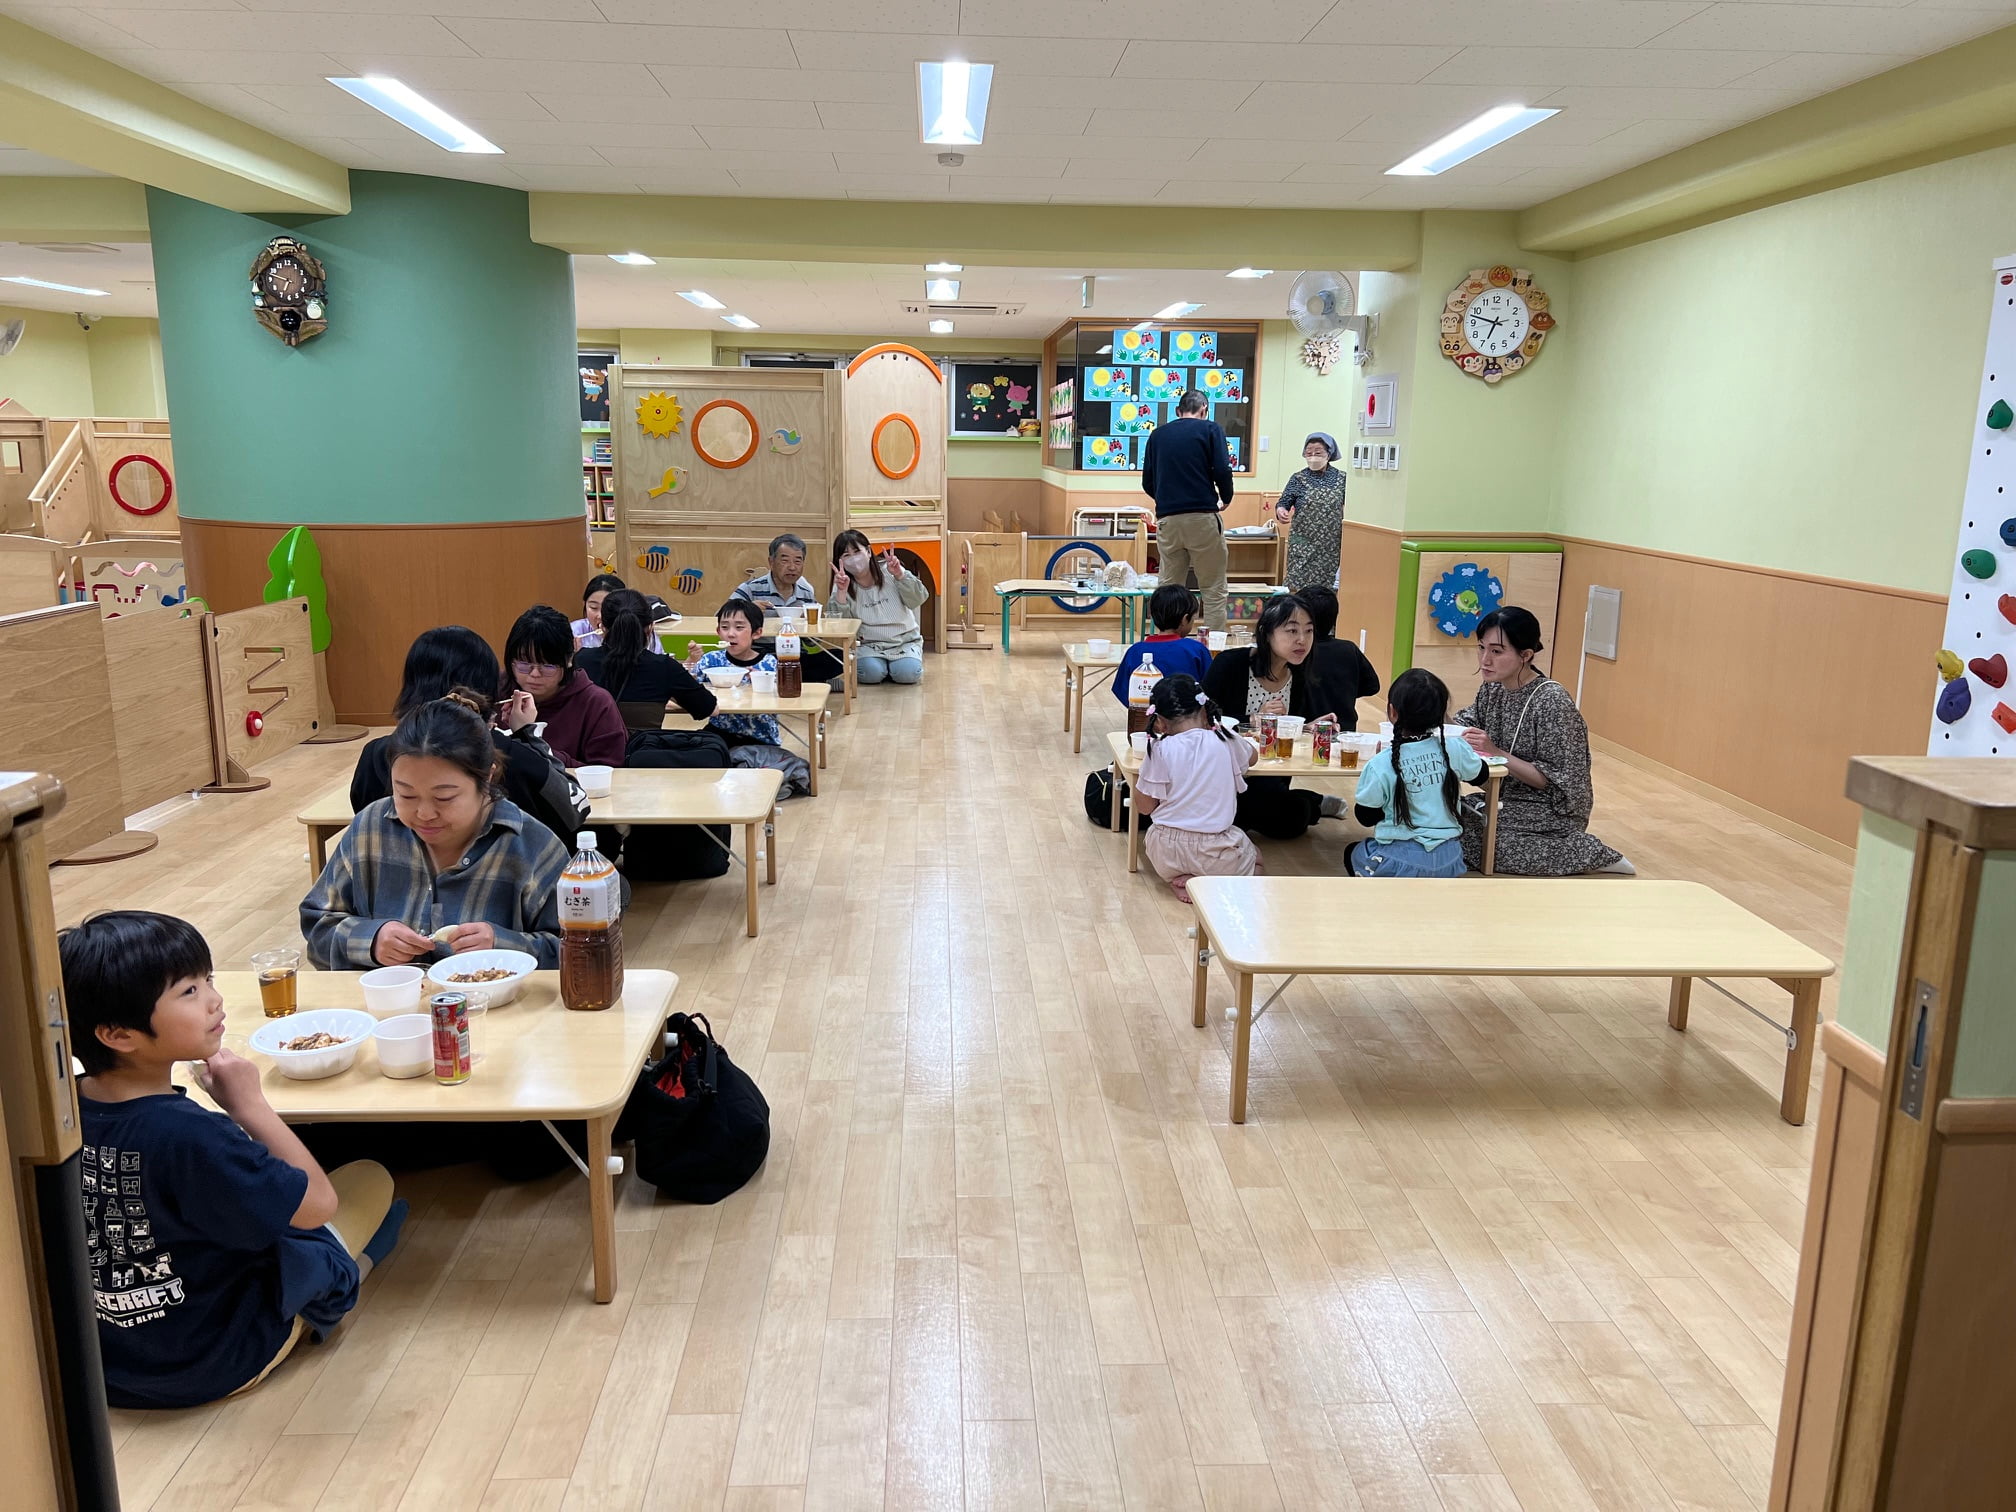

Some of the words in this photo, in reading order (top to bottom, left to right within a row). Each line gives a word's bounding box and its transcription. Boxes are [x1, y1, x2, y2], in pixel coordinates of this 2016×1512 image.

[1513, 307, 1518, 315] 2
[1510, 331, 1515, 339] 4
[565, 896, 590, 906] むぎ茶
[95, 1280, 182, 1311] ECRAFT
